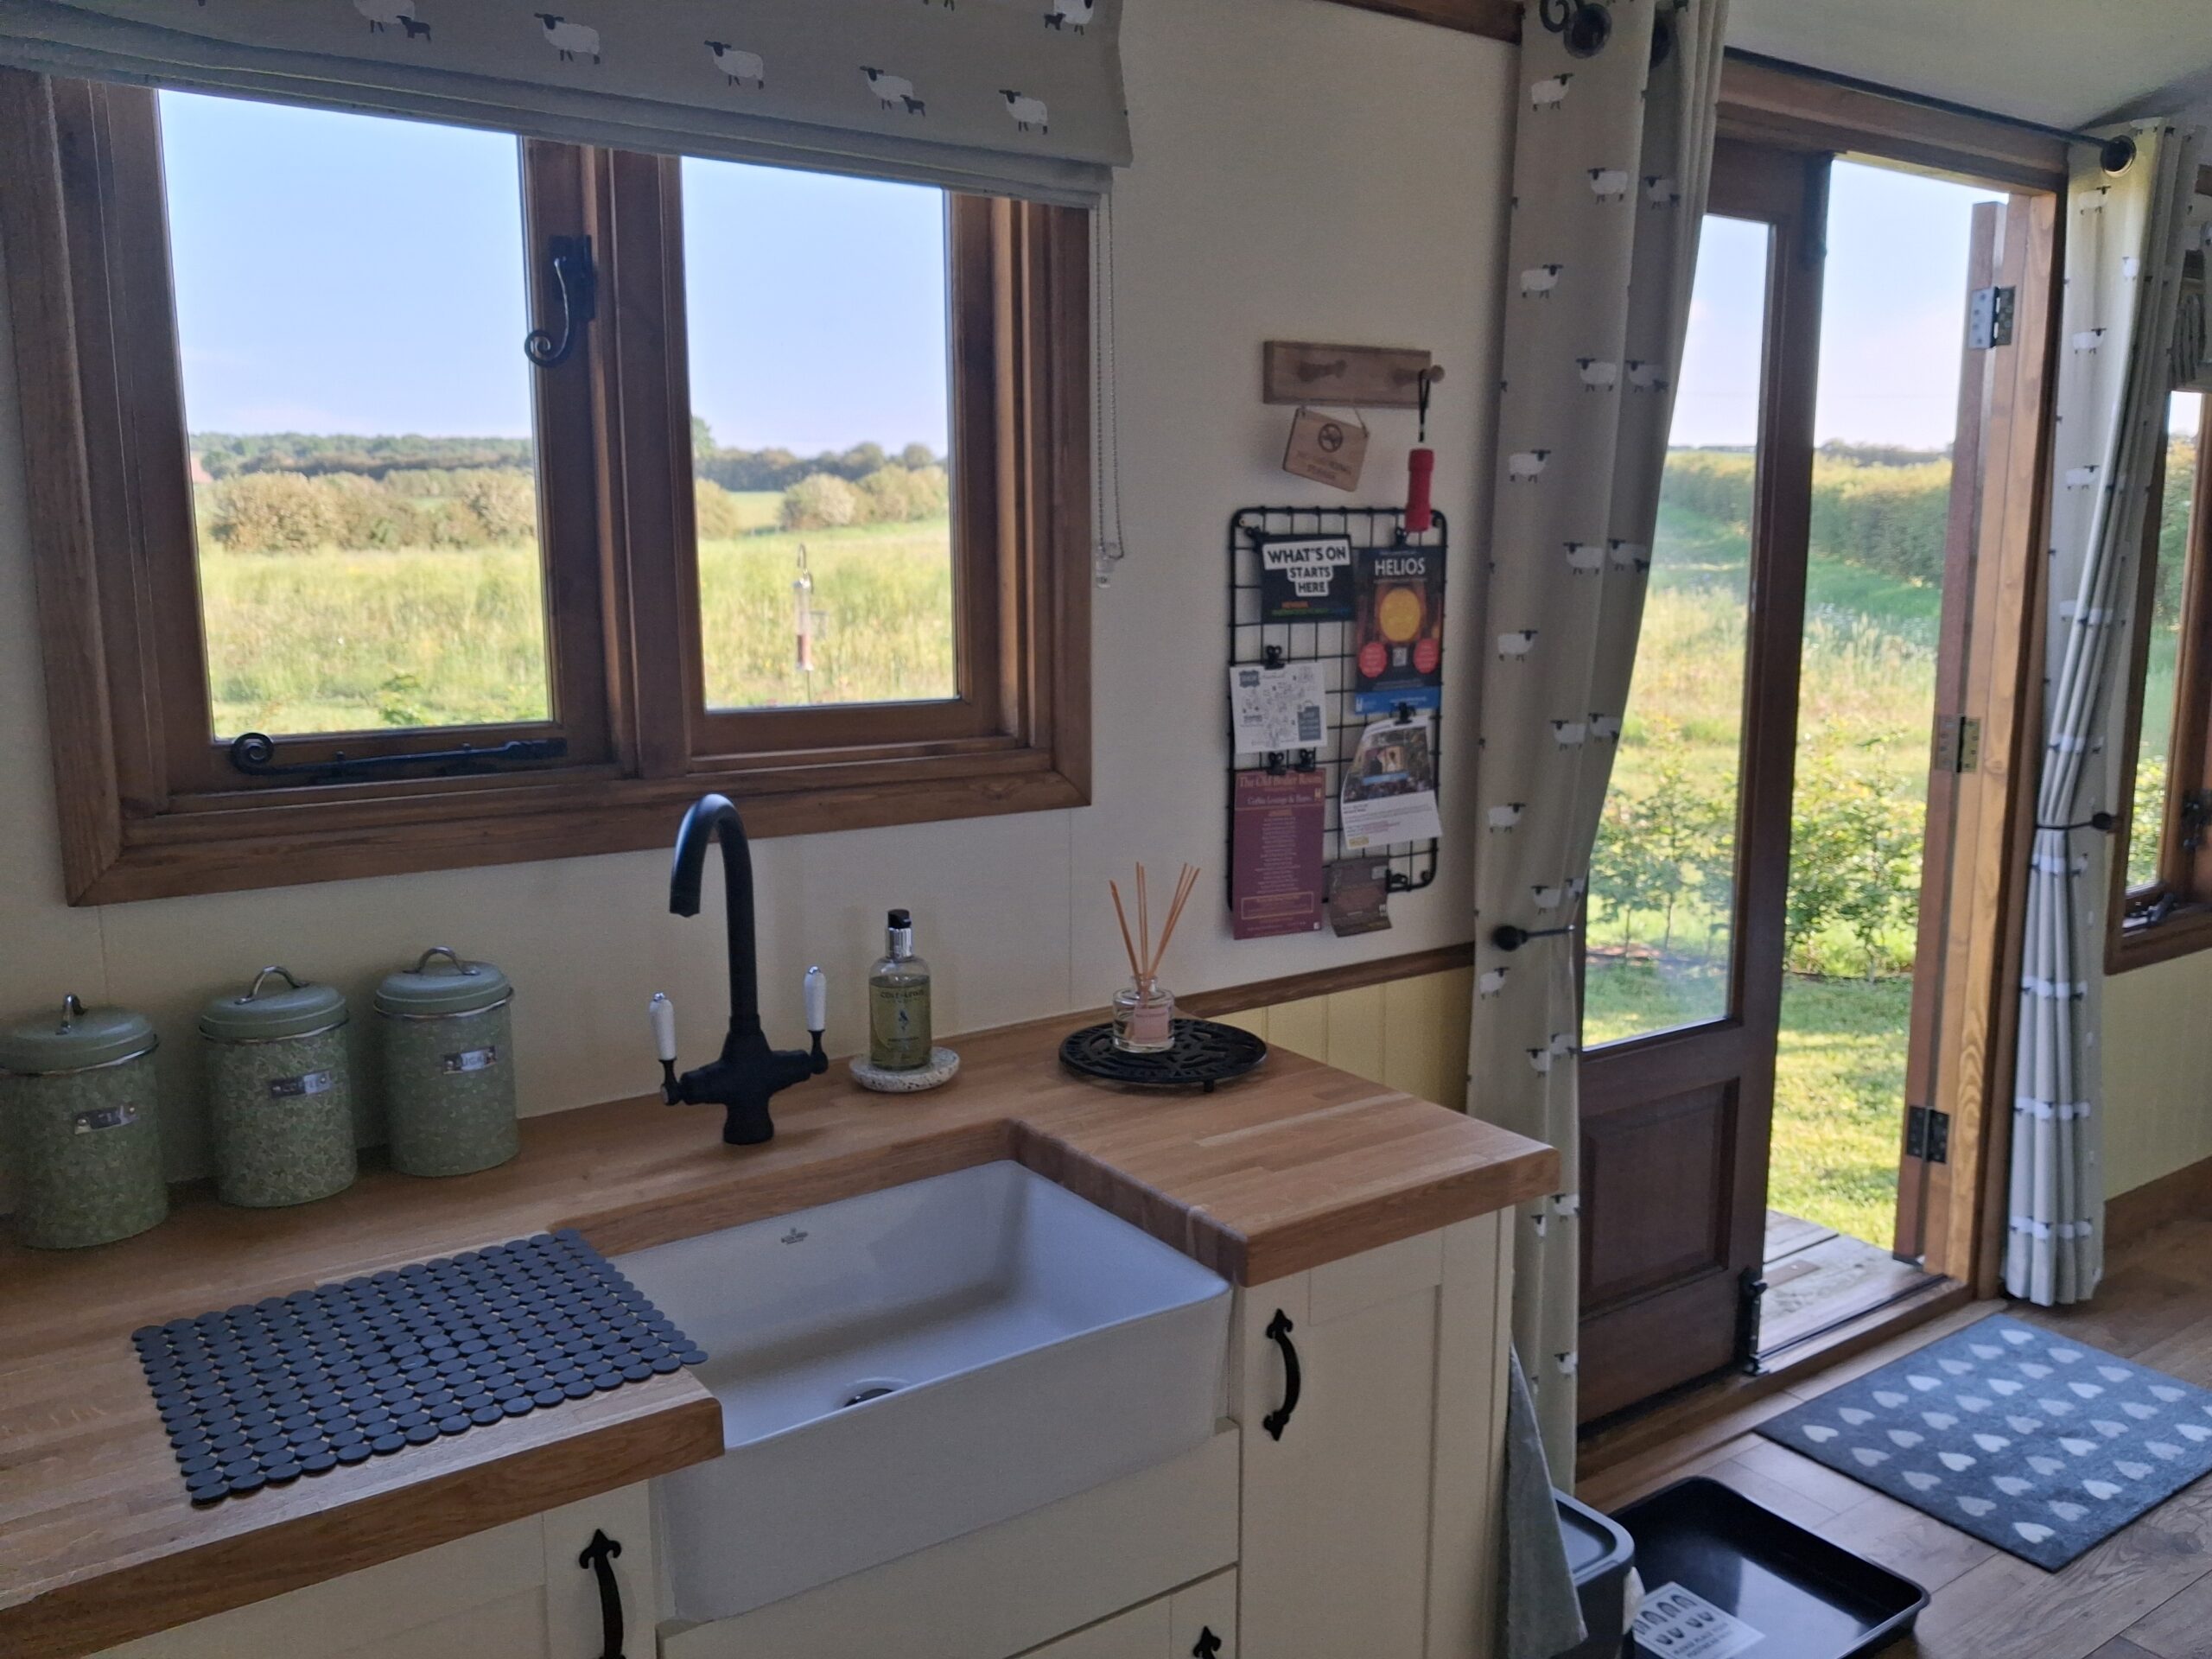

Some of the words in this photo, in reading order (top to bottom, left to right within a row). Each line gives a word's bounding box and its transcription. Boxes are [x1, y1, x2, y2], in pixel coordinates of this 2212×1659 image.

[1267, 547, 1323, 563] WHAT'S
[1325, 545, 1346, 561] ON
[1289, 566, 1331, 578] STARTS
[1374, 556, 1426, 576] HELIOS
[1298, 582, 1325, 594] HERE
